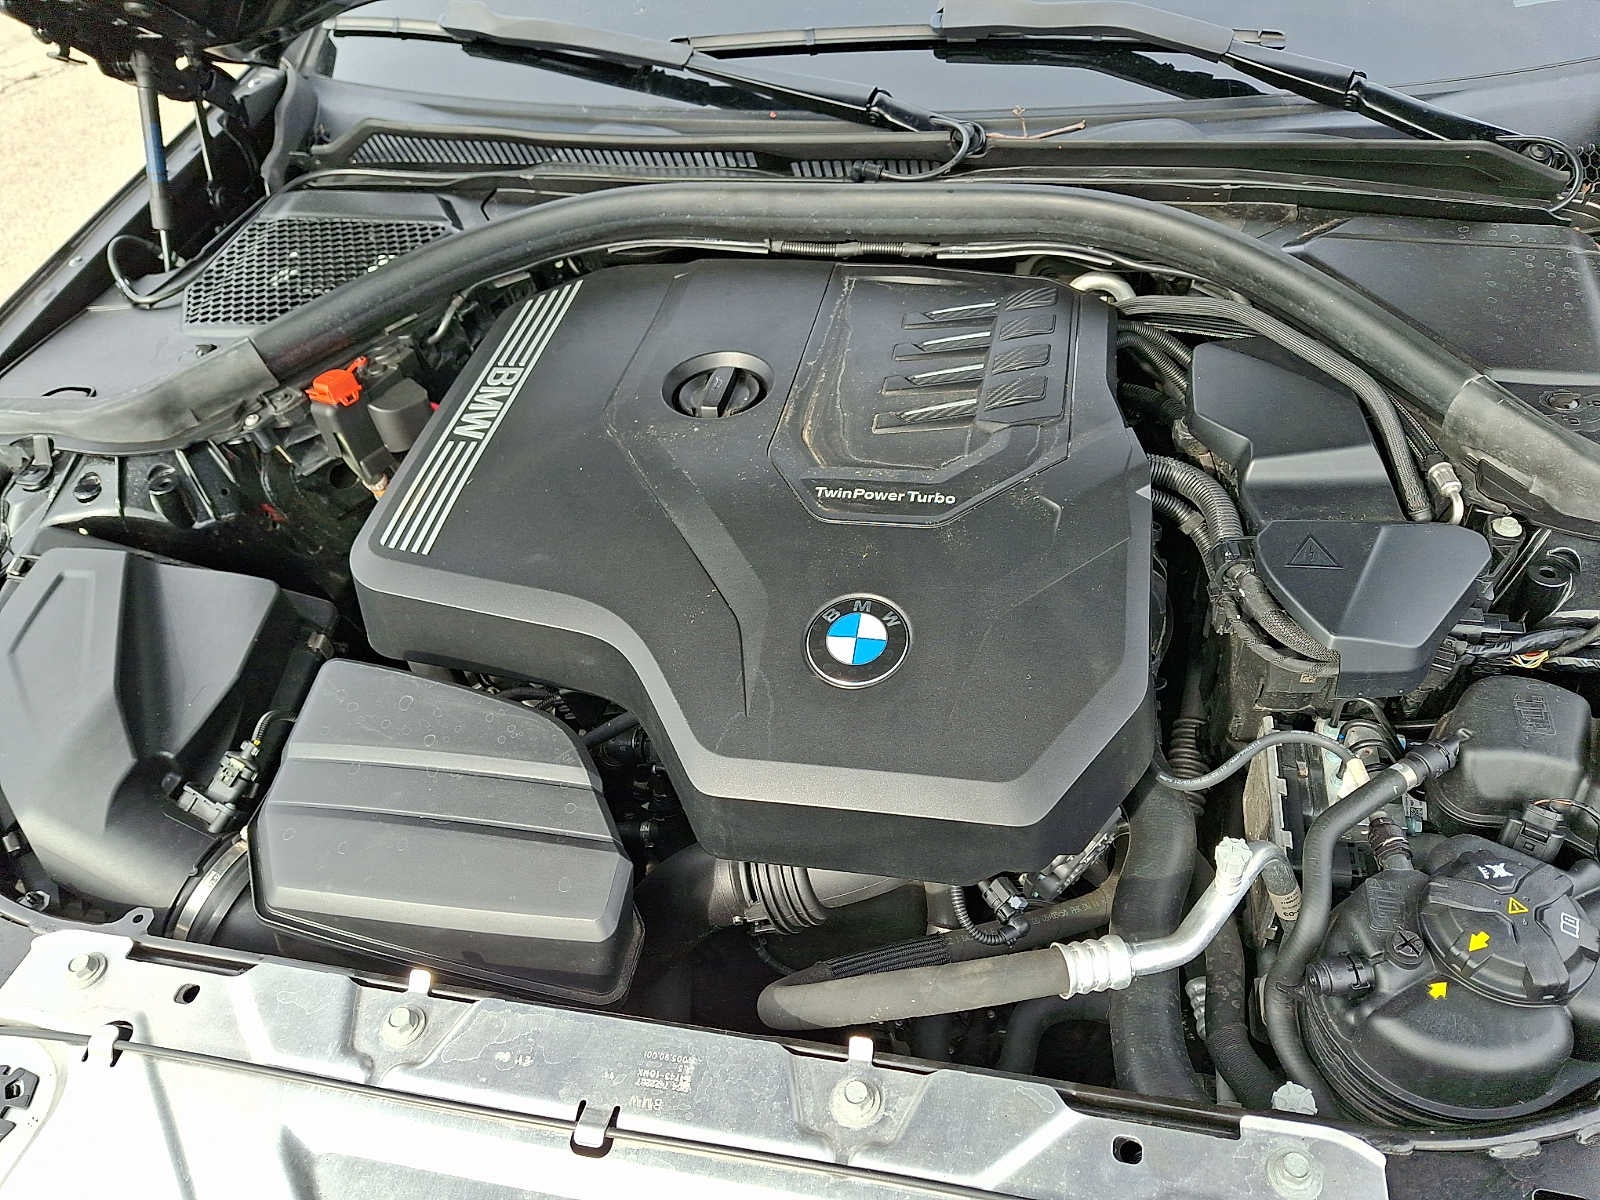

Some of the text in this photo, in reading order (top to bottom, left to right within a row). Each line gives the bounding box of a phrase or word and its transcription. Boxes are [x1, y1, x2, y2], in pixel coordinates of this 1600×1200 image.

[453, 367, 525, 440] BMW
[907, 490, 956, 504] Turbo
[822, 600, 901, 627] BMW
